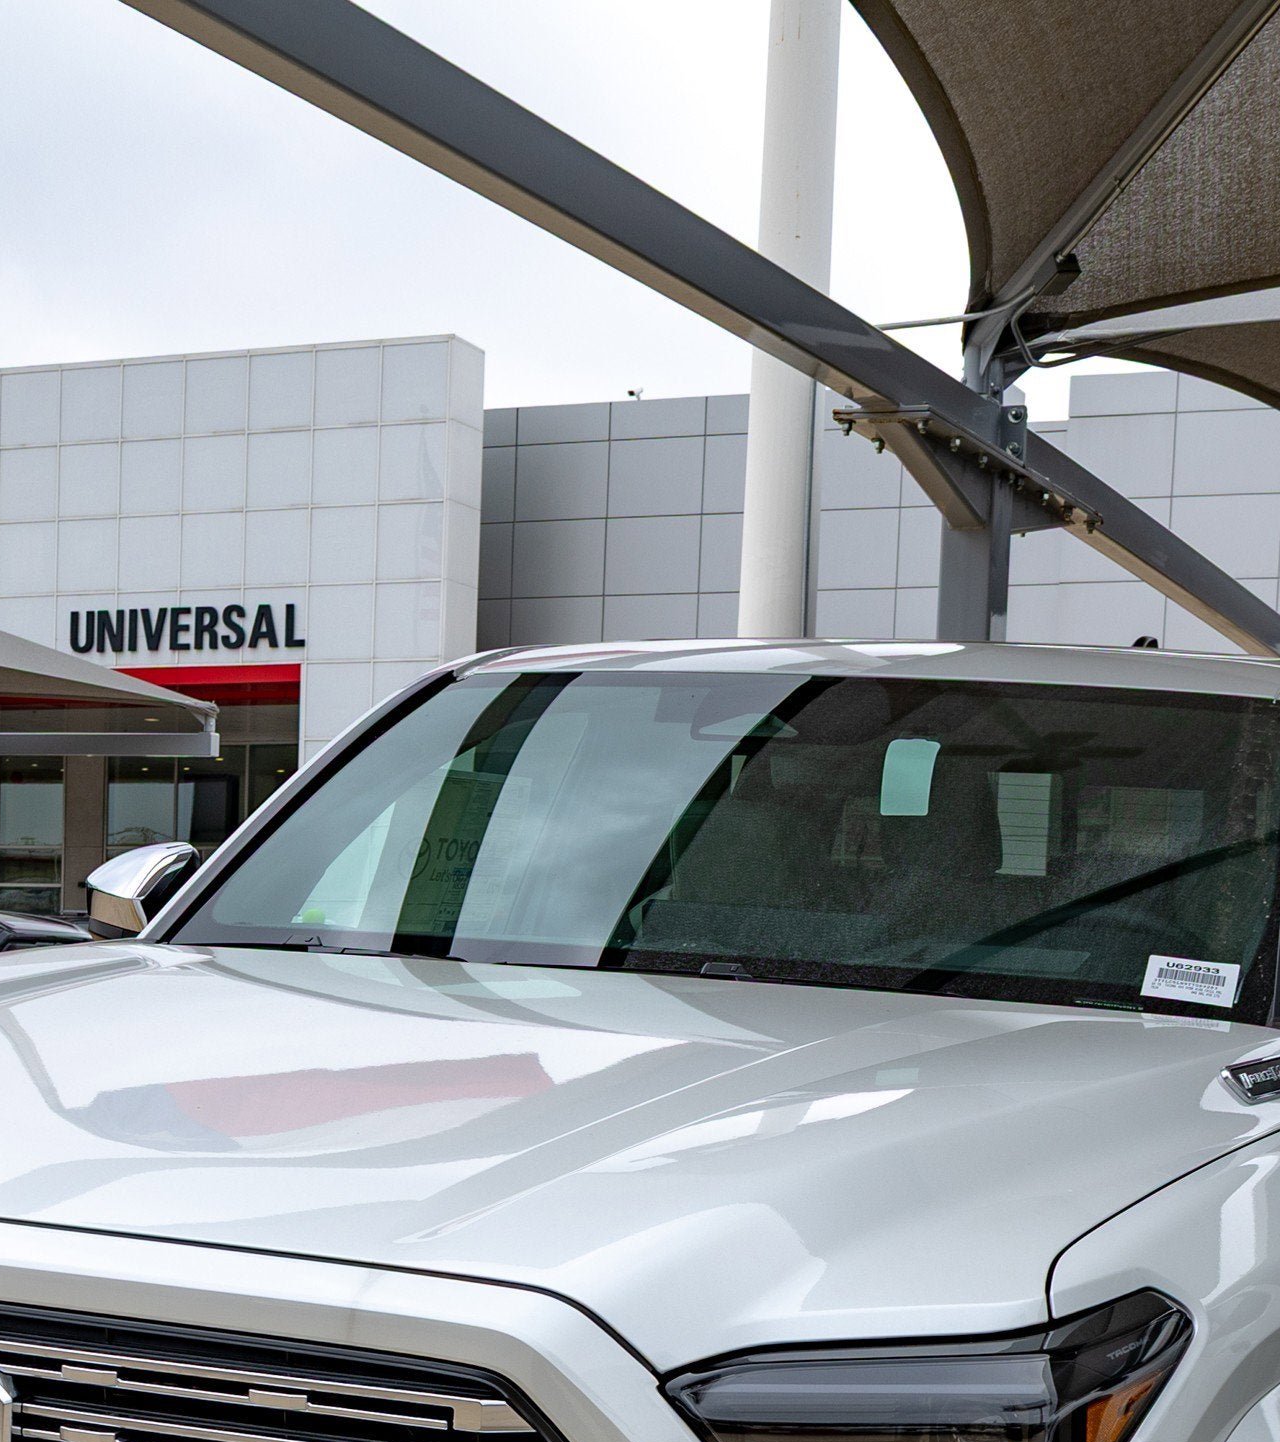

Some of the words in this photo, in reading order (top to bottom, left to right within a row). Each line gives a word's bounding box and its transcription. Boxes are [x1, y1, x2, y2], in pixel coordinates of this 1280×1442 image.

[70, 603, 306, 654] UNIVERSAL
[436, 837, 480, 862] TOYO
[1166, 961, 1220, 975] U62933
